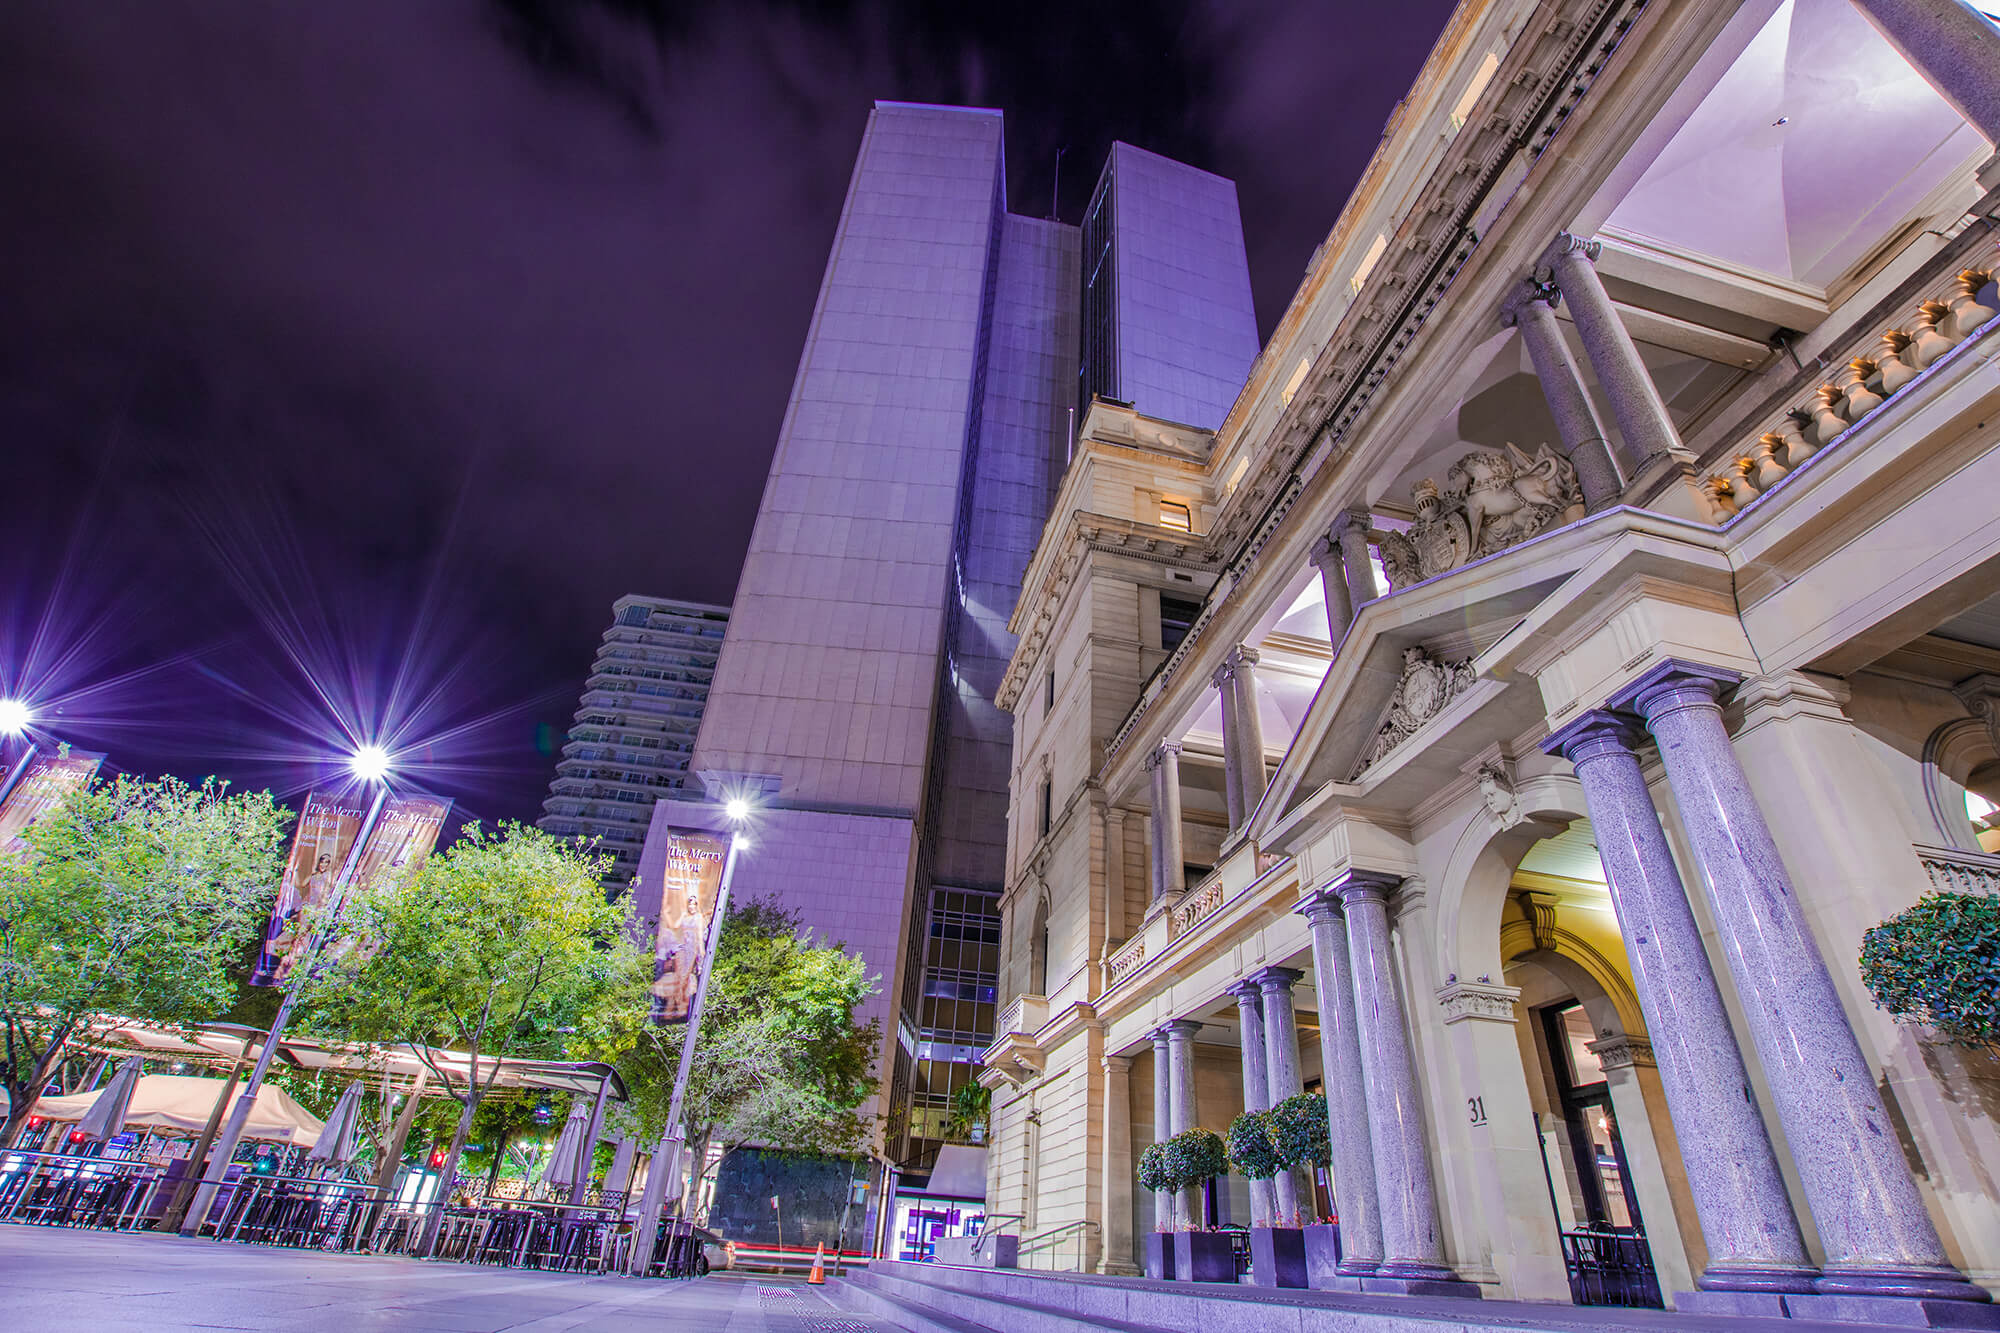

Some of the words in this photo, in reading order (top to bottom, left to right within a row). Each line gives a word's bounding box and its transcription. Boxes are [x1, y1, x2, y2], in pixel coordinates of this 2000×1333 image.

[310, 803, 330, 815] The
[332, 804, 366, 821] Merry
[383, 809, 406, 821] The
[408, 812, 442, 829] Merry
[669, 846, 688, 857] The
[689, 847, 723, 863] Merry
[669, 858, 702, 873] Widow
[1467, 1095, 1488, 1123] 31
